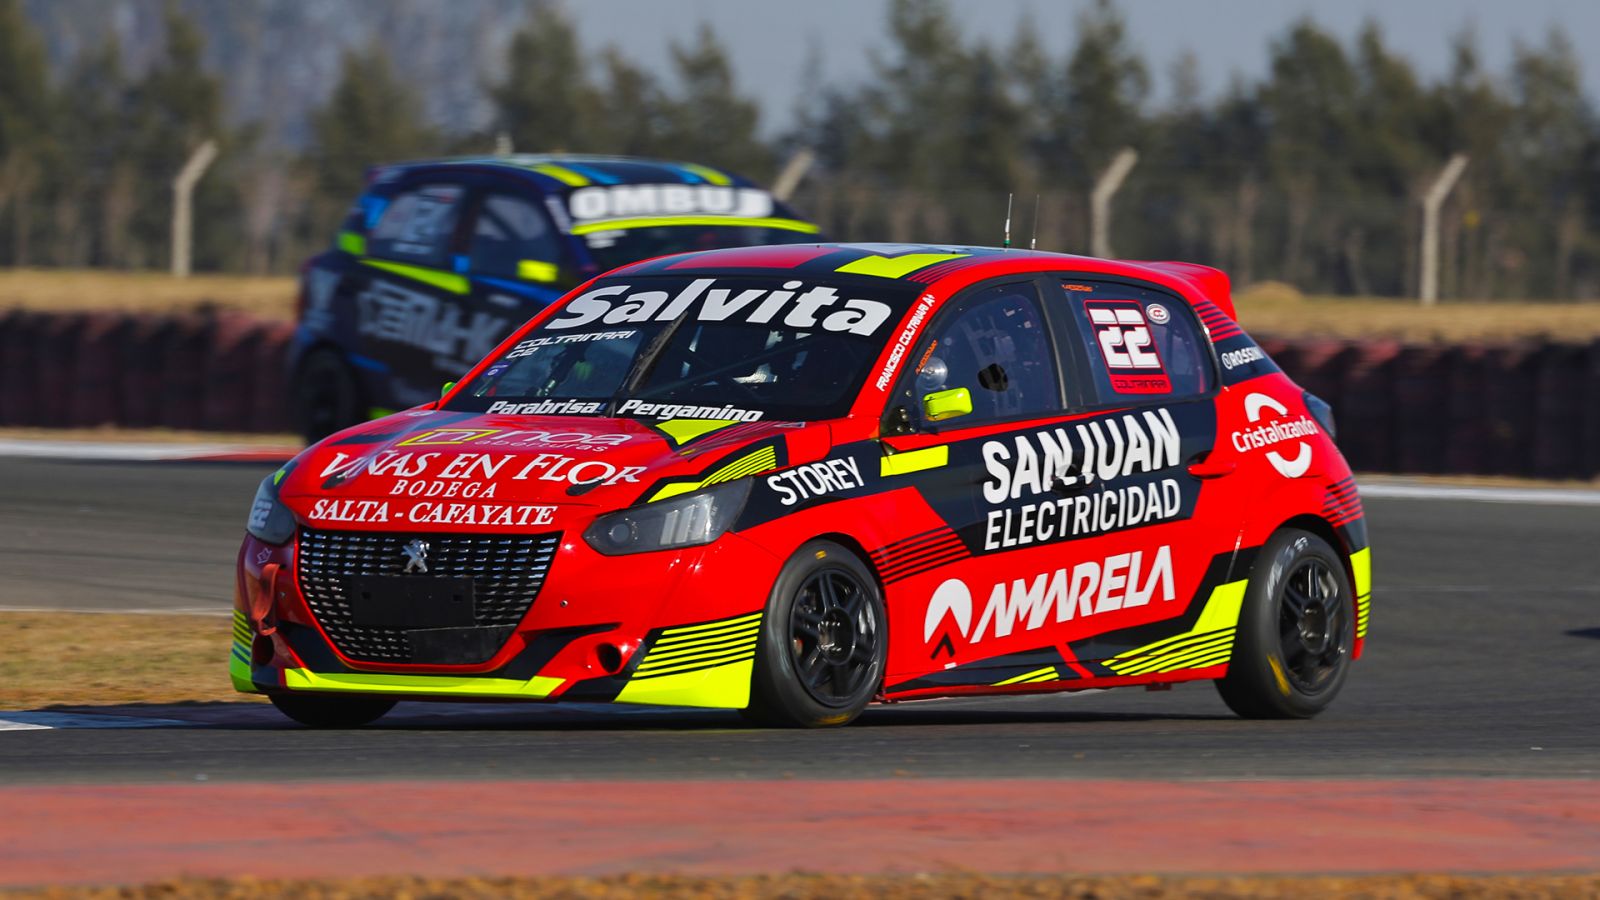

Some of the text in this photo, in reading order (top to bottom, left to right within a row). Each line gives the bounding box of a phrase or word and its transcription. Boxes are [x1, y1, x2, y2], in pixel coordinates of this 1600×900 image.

[545, 279, 893, 337] Salvita
[514, 330, 638, 350] COLTRINARI
[875, 343, 906, 392] FRANCISCO
[899, 303, 930, 346] COLTRINARI
[1088, 308, 1162, 369] 22
[616, 398, 764, 422] Pergamino
[474, 440, 610, 452] aberturas
[491, 430, 634, 446] noa
[1231, 415, 1319, 453] Cristalizando
[437, 453, 517, 480] EN
[512, 453, 648, 486] FLOR
[766, 456, 865, 506] STOREY
[389, 479, 499, 499] BODEGA
[308, 498, 390, 523] SALTA
[408, 501, 558, 526] CAFAYATE
[984, 478, 1181, 551] ELECTRICIDAD
[969, 545, 1176, 644] AMARELA
